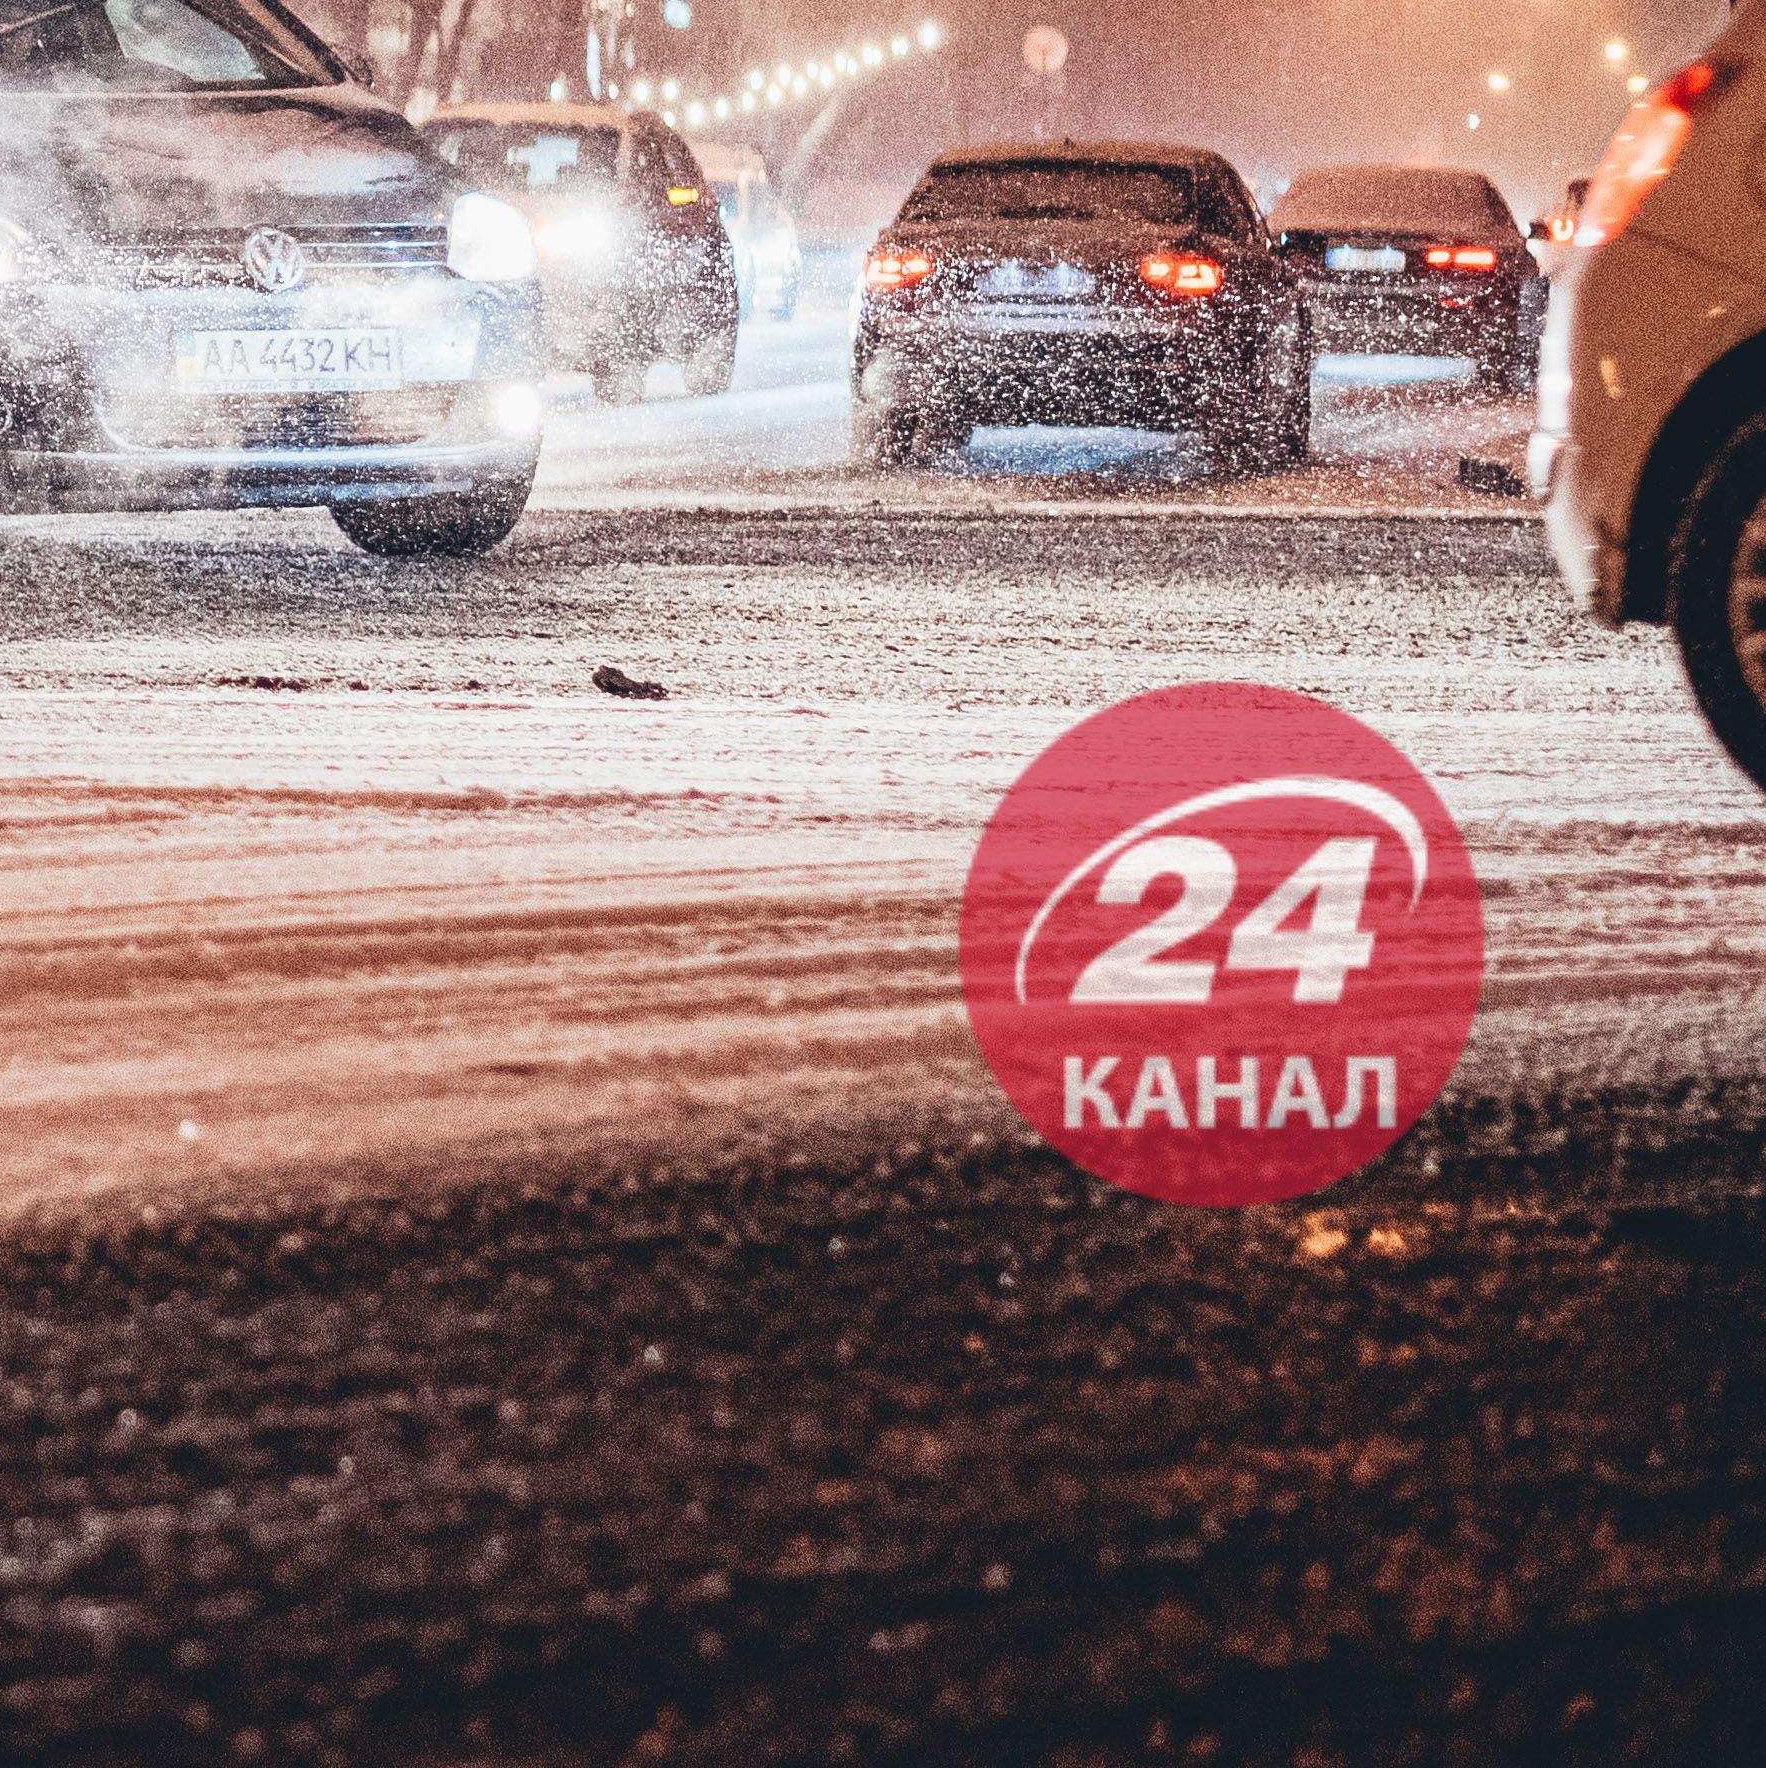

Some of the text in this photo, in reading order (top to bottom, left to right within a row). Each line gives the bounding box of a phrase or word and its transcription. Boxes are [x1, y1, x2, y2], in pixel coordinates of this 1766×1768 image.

[204, 336, 392, 374] AA 4432 KH
